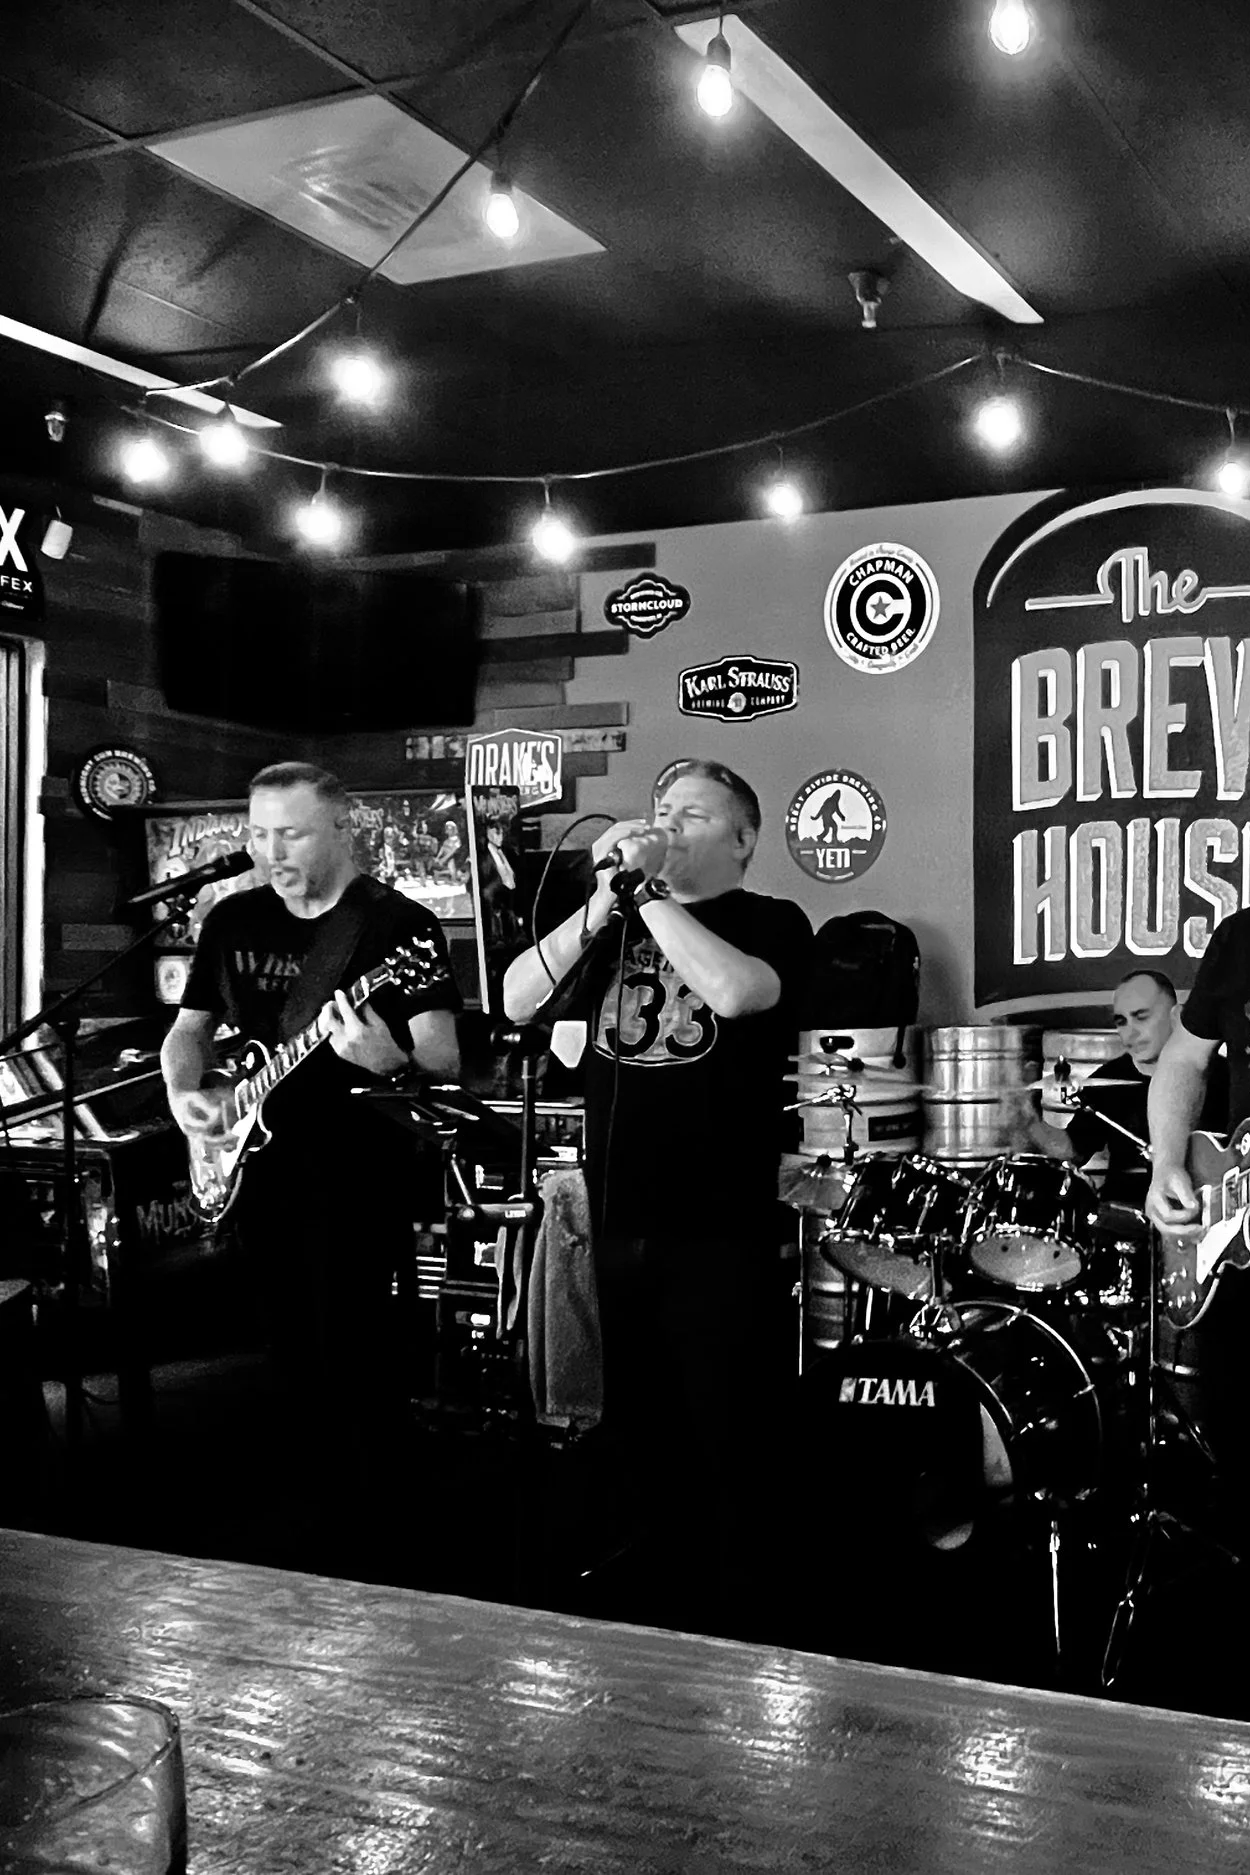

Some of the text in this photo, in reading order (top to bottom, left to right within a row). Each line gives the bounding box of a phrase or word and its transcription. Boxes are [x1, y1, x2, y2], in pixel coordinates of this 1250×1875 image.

[849, 560, 914, 586] CHAPMAN
[1097, 546, 1208, 623] The
[611, 599, 683, 613] STORMCLOUD
[846, 628, 917, 656] CRAFTED BEER
[685, 666, 792, 699] KARL STRAUSS
[815, 848, 851, 868] YETI
[858, 1377, 936, 1407] TAMA
